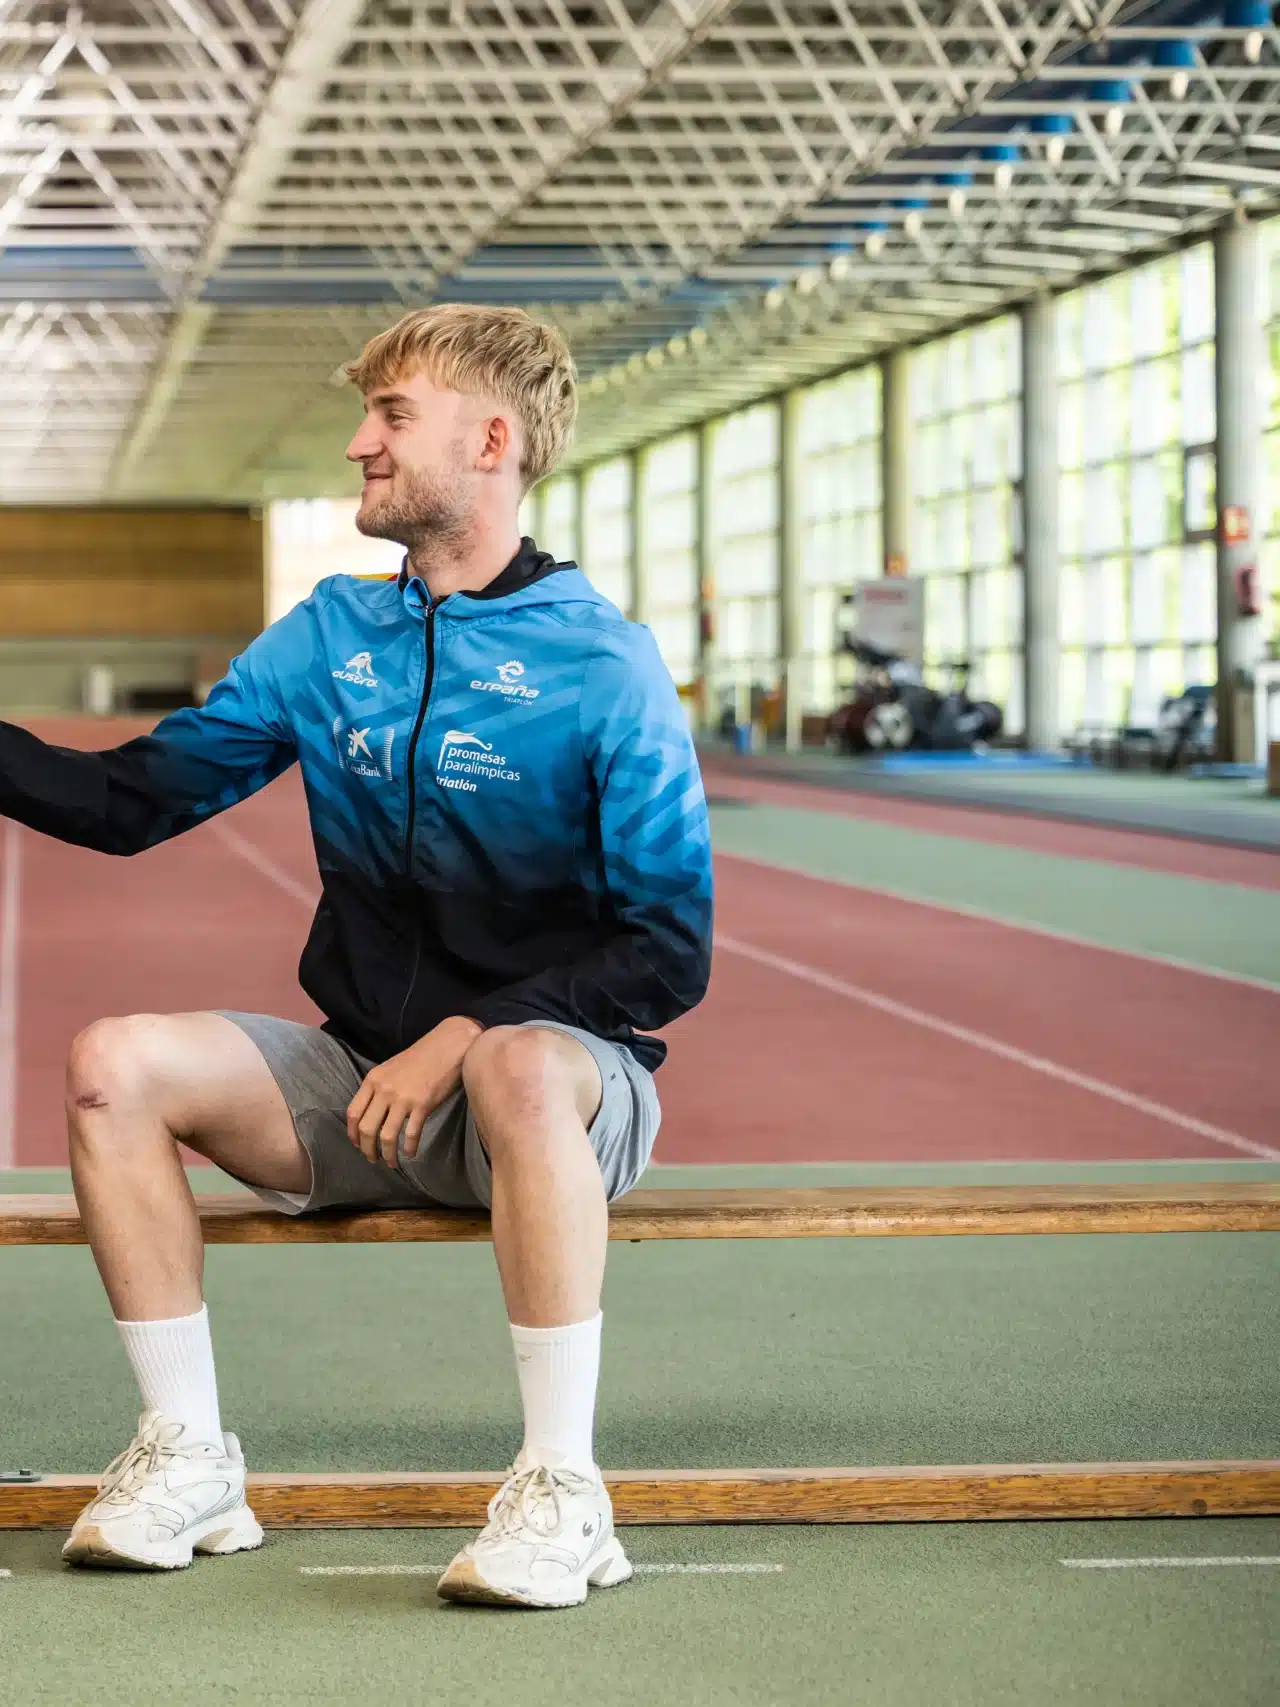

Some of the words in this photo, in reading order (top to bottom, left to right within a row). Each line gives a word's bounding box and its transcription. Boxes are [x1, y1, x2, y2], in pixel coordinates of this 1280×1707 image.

[470, 680, 539, 698] españa
[447, 747, 506, 765] promesas
[444, 760, 520, 781] paralímpicas
